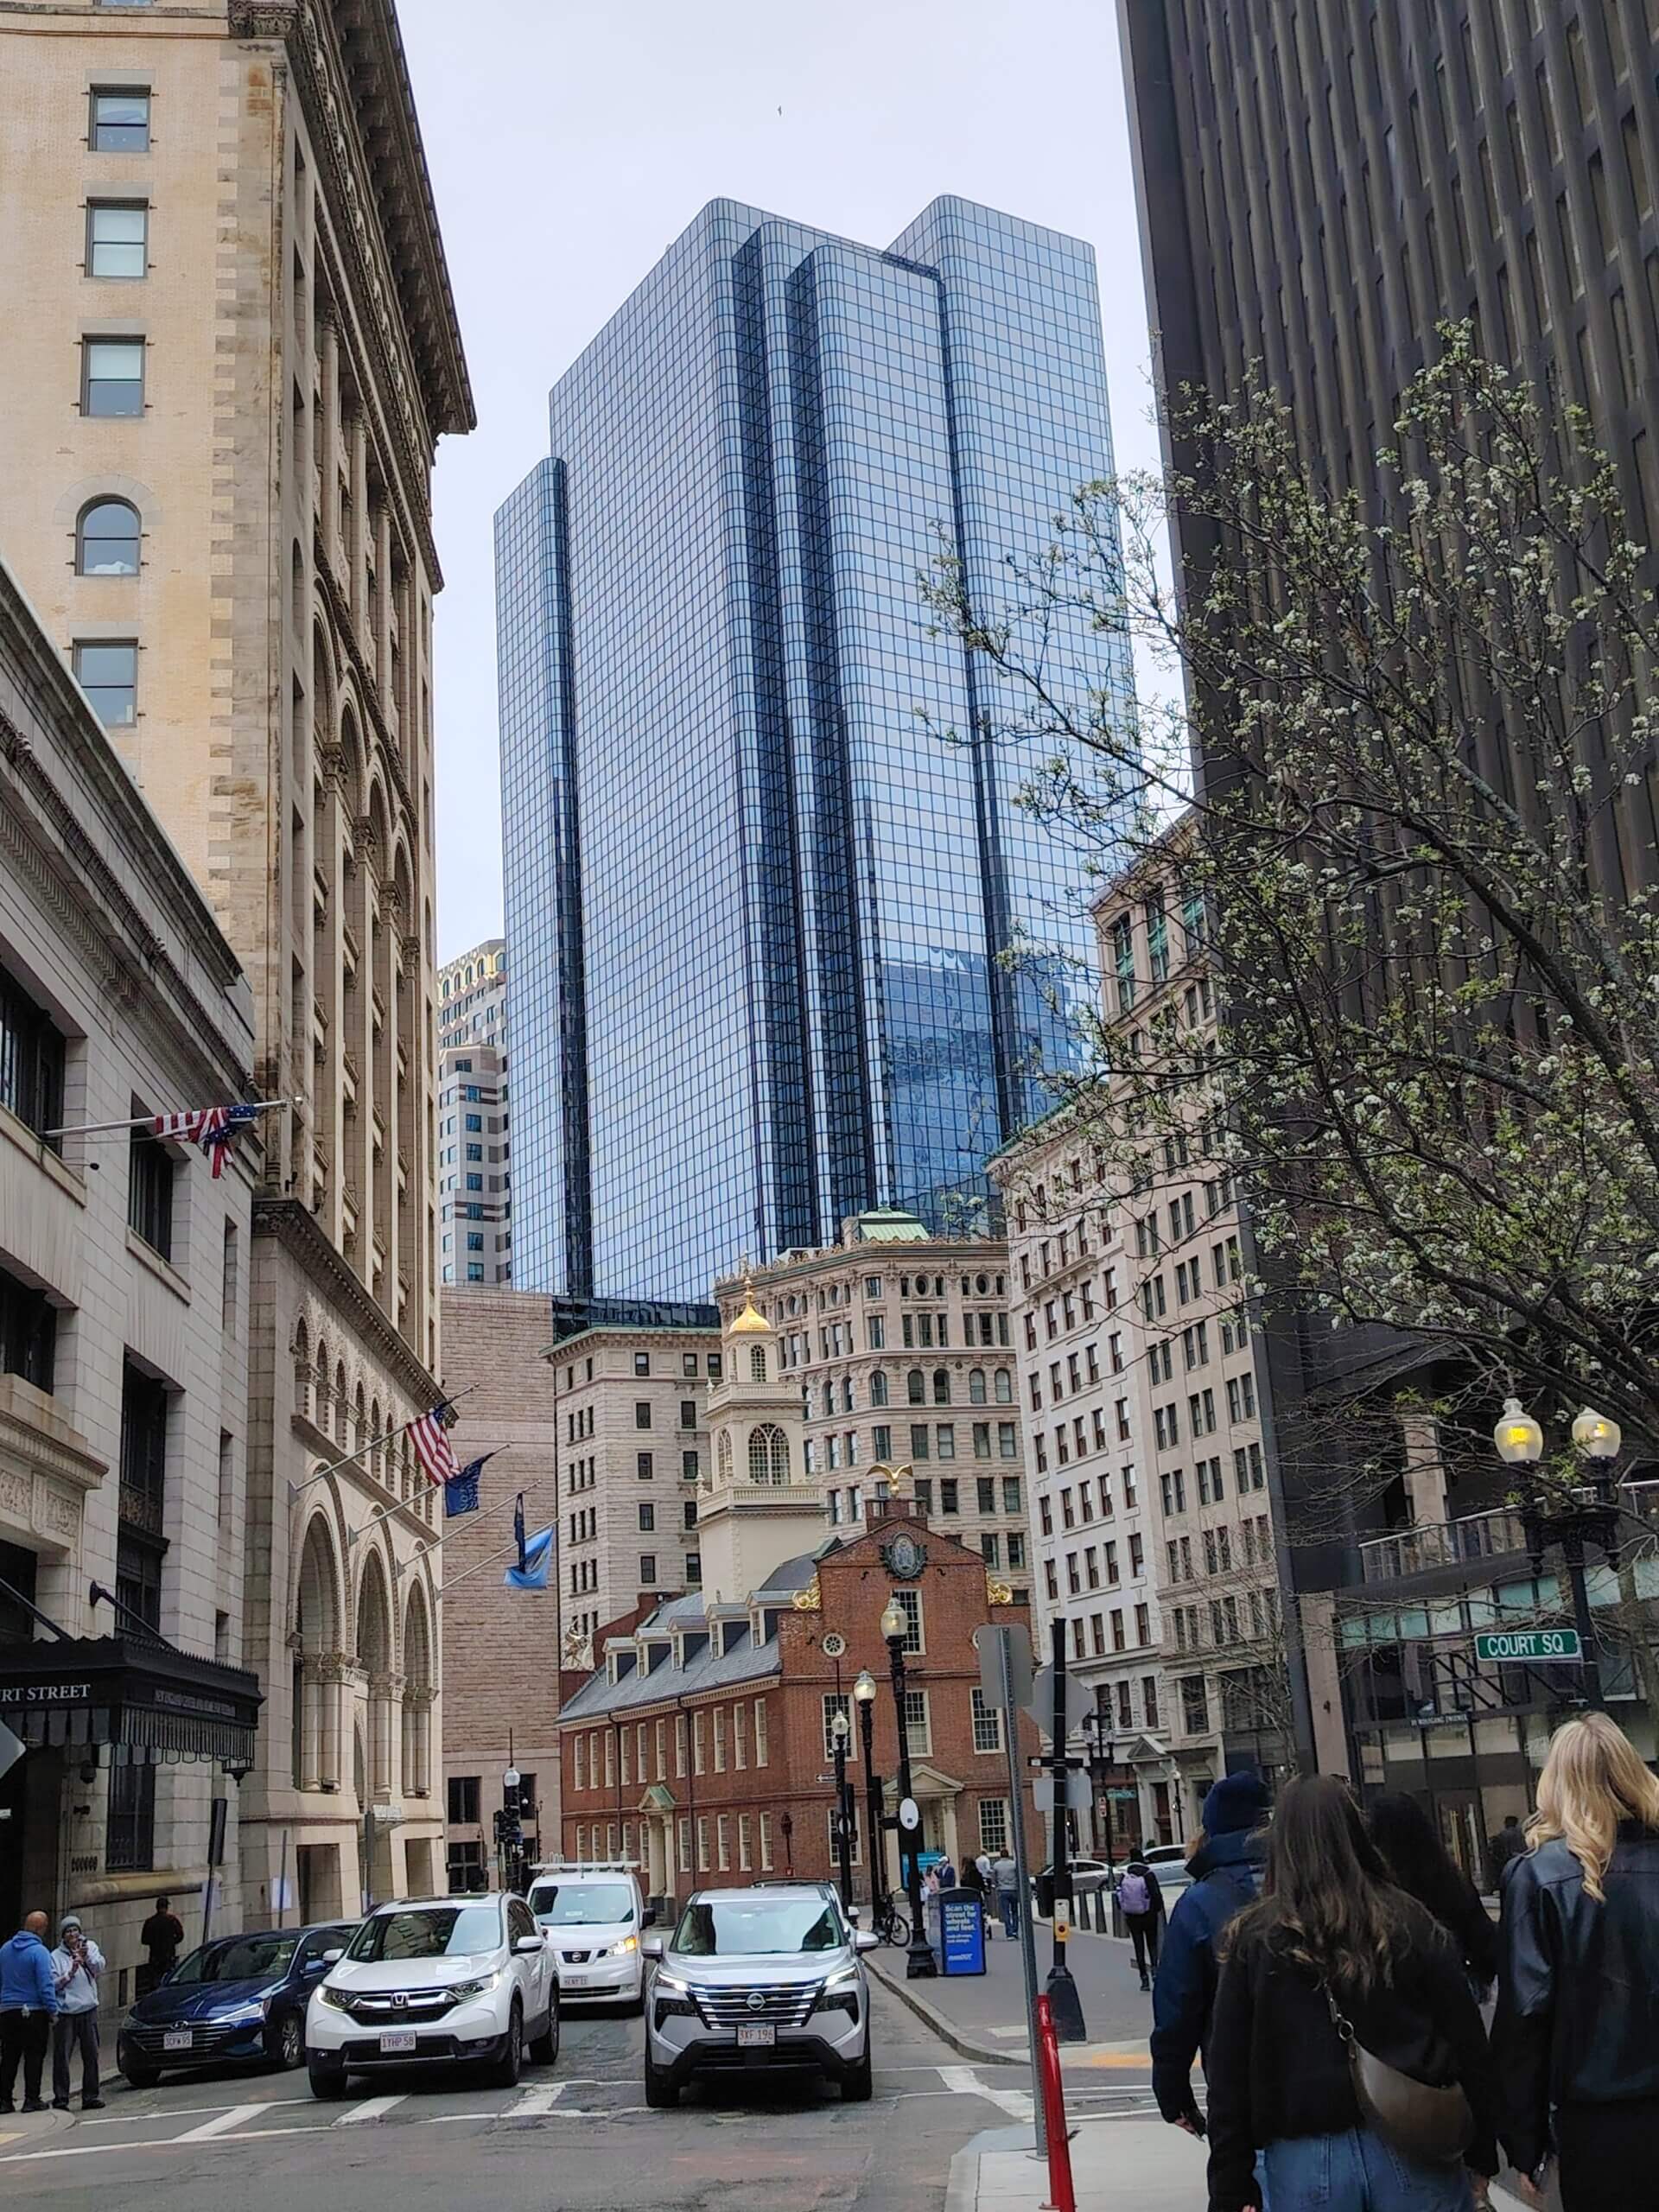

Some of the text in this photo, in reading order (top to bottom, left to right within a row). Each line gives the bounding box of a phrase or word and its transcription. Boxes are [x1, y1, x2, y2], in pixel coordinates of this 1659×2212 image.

[1487, 1633, 1565, 1656] COURT SQ
[0, 1684, 91, 1701] RT STREET
[403, 2036, 415, 2047] 58
[758, 2029, 773, 2040] 196
